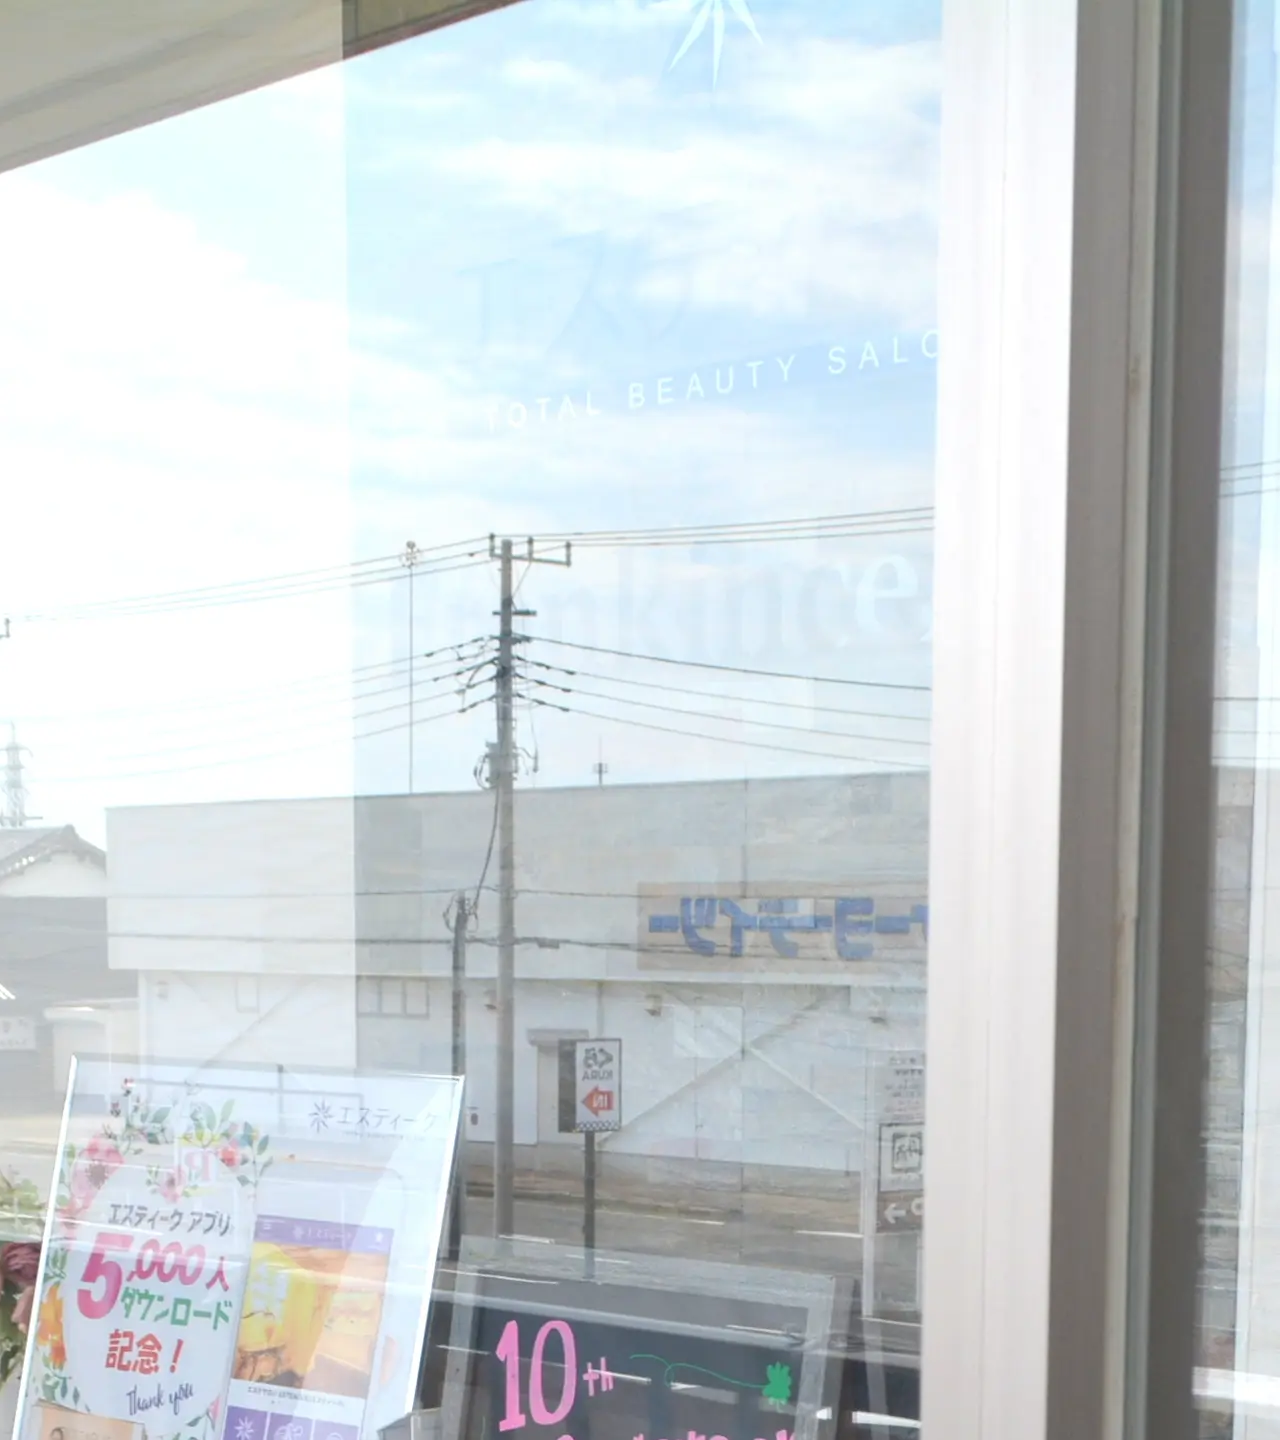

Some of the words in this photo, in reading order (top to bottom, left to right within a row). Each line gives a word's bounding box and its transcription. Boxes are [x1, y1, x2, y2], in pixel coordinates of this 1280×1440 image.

[628, 355, 796, 410] BEAUTY
[336, 1105, 439, 1134] エスティーク
[108, 1203, 184, 1232] エスティーク
[187, 1210, 233, 1237] アプリ
[77, 1232, 231, 1320] 5,000人
[121, 1286, 233, 1331] ダウンロード
[496, 1319, 614, 1432] 10th
[126, 1383, 164, 1417] Thank
[169, 1382, 194, 1416] you
